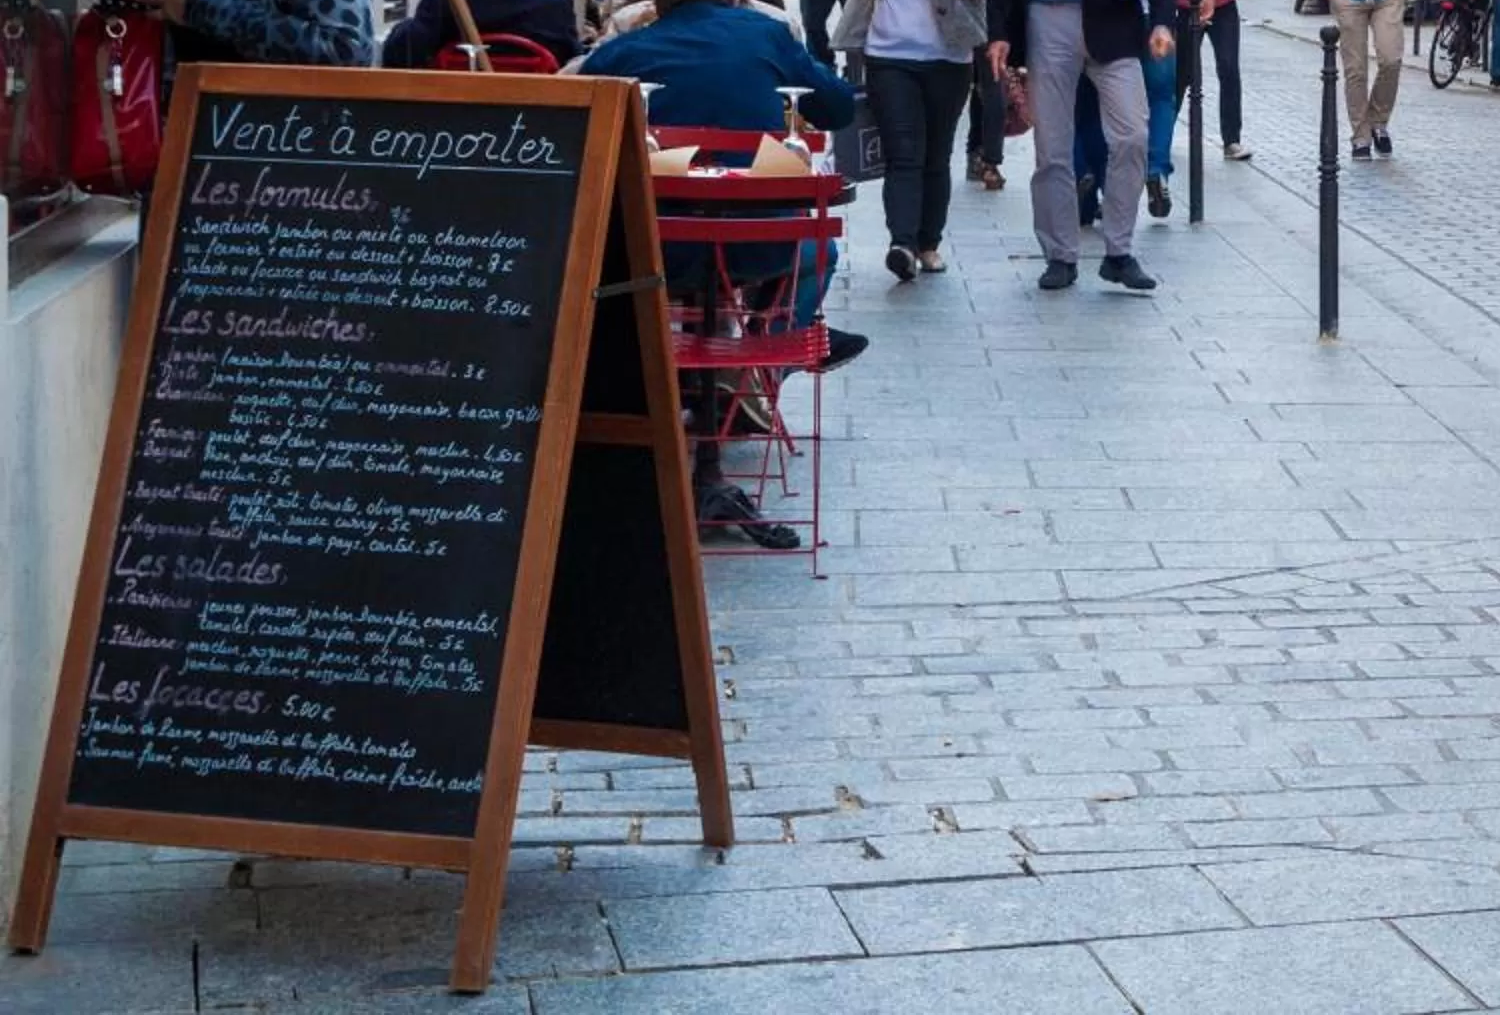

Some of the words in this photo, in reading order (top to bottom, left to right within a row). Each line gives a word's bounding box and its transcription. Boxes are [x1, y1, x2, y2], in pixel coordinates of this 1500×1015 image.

[212, 101, 315, 153] Vente
[330, 109, 356, 156] à
[370, 112, 563, 180] emporter
[191, 162, 241, 205] Les
[192, 214, 271, 236] Sandwich
[268, 218, 328, 244] jambon
[332, 229, 353, 240] ou
[356, 224, 401, 245] mixte
[408, 234, 428, 245] ou
[435, 225, 528, 250] chameleon
[326, 249, 345, 262] ou
[231, 265, 248, 276] ou
[309, 270, 327, 282] ou
[331, 266, 402, 286] sandwich
[467, 278, 488, 288] ou
[163, 297, 213, 334] Les
[115, 535, 168, 577] Les
[89, 660, 141, 704] Les
